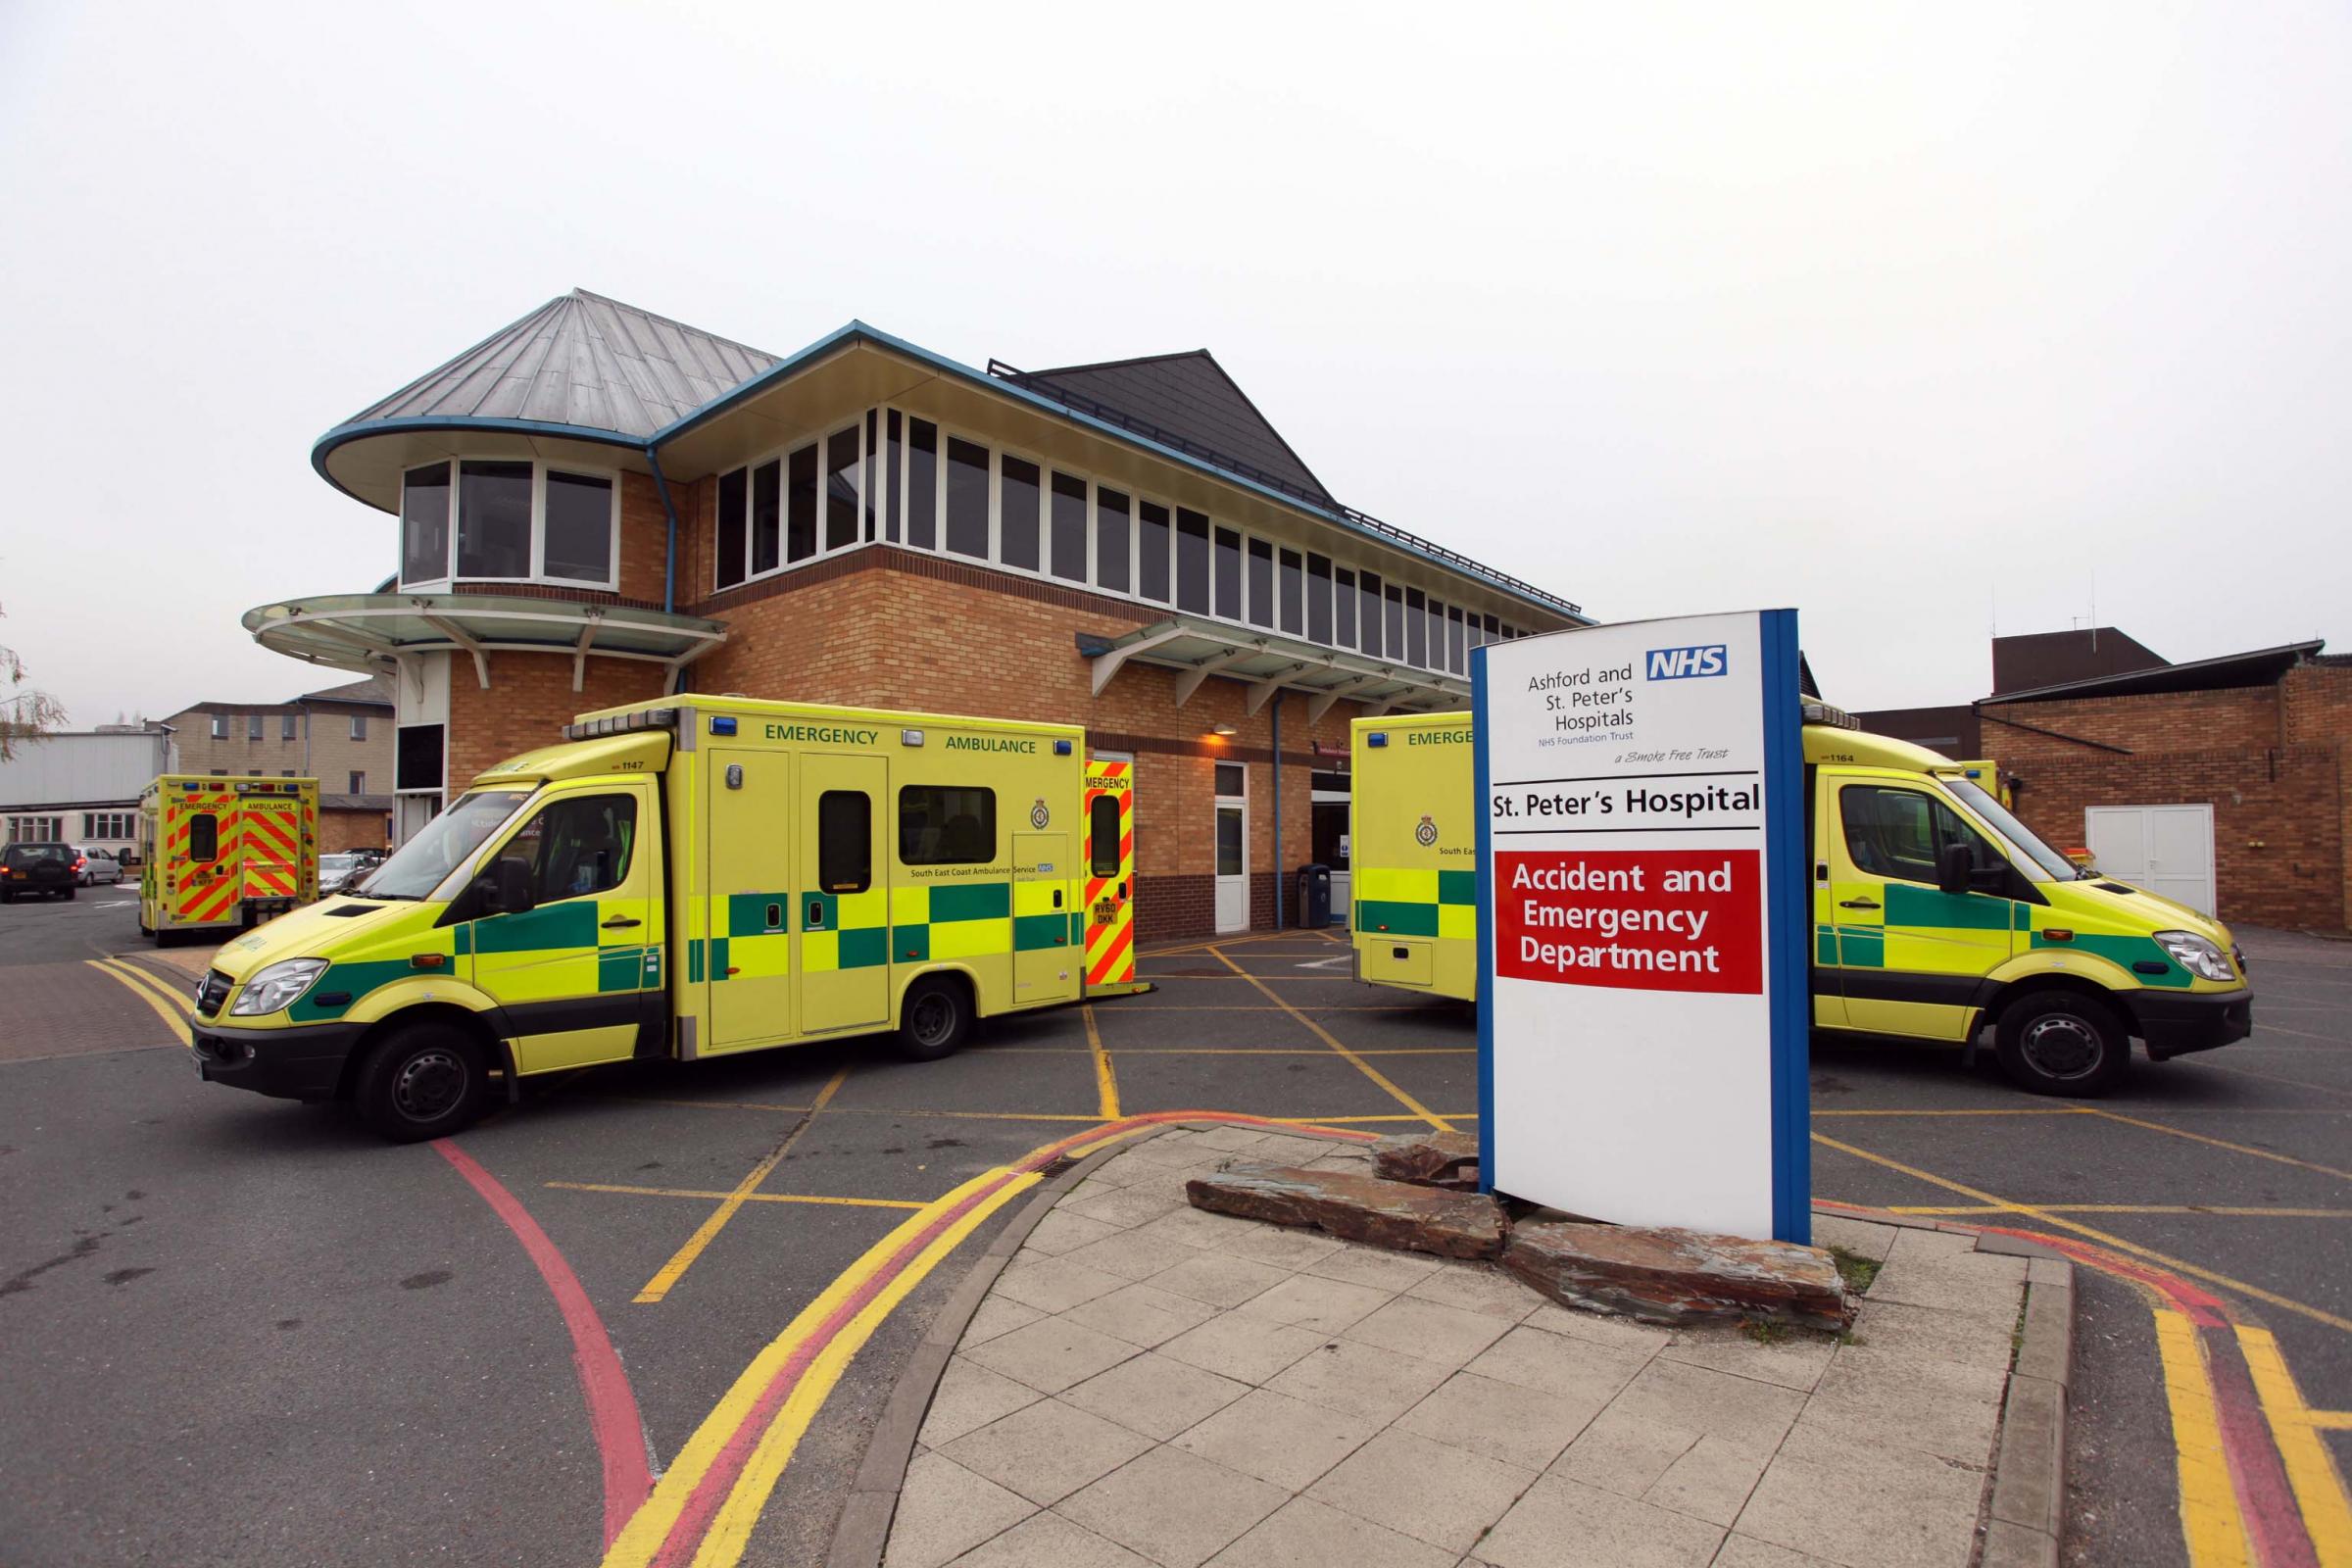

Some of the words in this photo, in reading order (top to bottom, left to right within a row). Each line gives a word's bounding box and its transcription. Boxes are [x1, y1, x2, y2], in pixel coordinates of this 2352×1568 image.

[1648, 647, 1725, 678] NHS
[1528, 668, 1591, 692] Ashford
[1598, 663, 1632, 683] and
[1546, 695, 1565, 710] St.
[1572, 687, 1633, 708] Peter's
[1555, 709, 1634, 732] Hospitals
[765, 724, 878, 745] EMERGENCY
[946, 736, 1036, 754] AMBULANCE
[1408, 730, 1474, 745] EMERGE
[1539, 738, 1555, 747] NHS
[1557, 733, 1607, 745] Foundation
[1610, 731, 1634, 741] Trust
[622, 760, 644, 769] 1147
[1615, 755, 1622, 763] a
[1625, 751, 1666, 762] Smoke
[1668, 749, 1691, 760] Free
[1696, 748, 1730, 760] Trust
[1085, 776, 1130, 789] MERGENCY
[179, 802, 227, 811] EMERGENCY
[247, 802, 293, 811] AMBULANCE
[1494, 796, 1519, 817] St.
[1527, 791, 1613, 816] Peter's
[1626, 783, 1760, 818] Hospital
[911, 869, 933, 878] South
[935, 868, 950, 877] East
[952, 867, 971, 876] Coast
[973, 866, 1010, 875] Ambulance
[1013, 865, 1036, 874] Service
[1512, 860, 1645, 892] Accident
[1662, 860, 1732, 893] and
[1524, 899, 1709, 941] Emergency
[1521, 935, 1720, 973] Department
